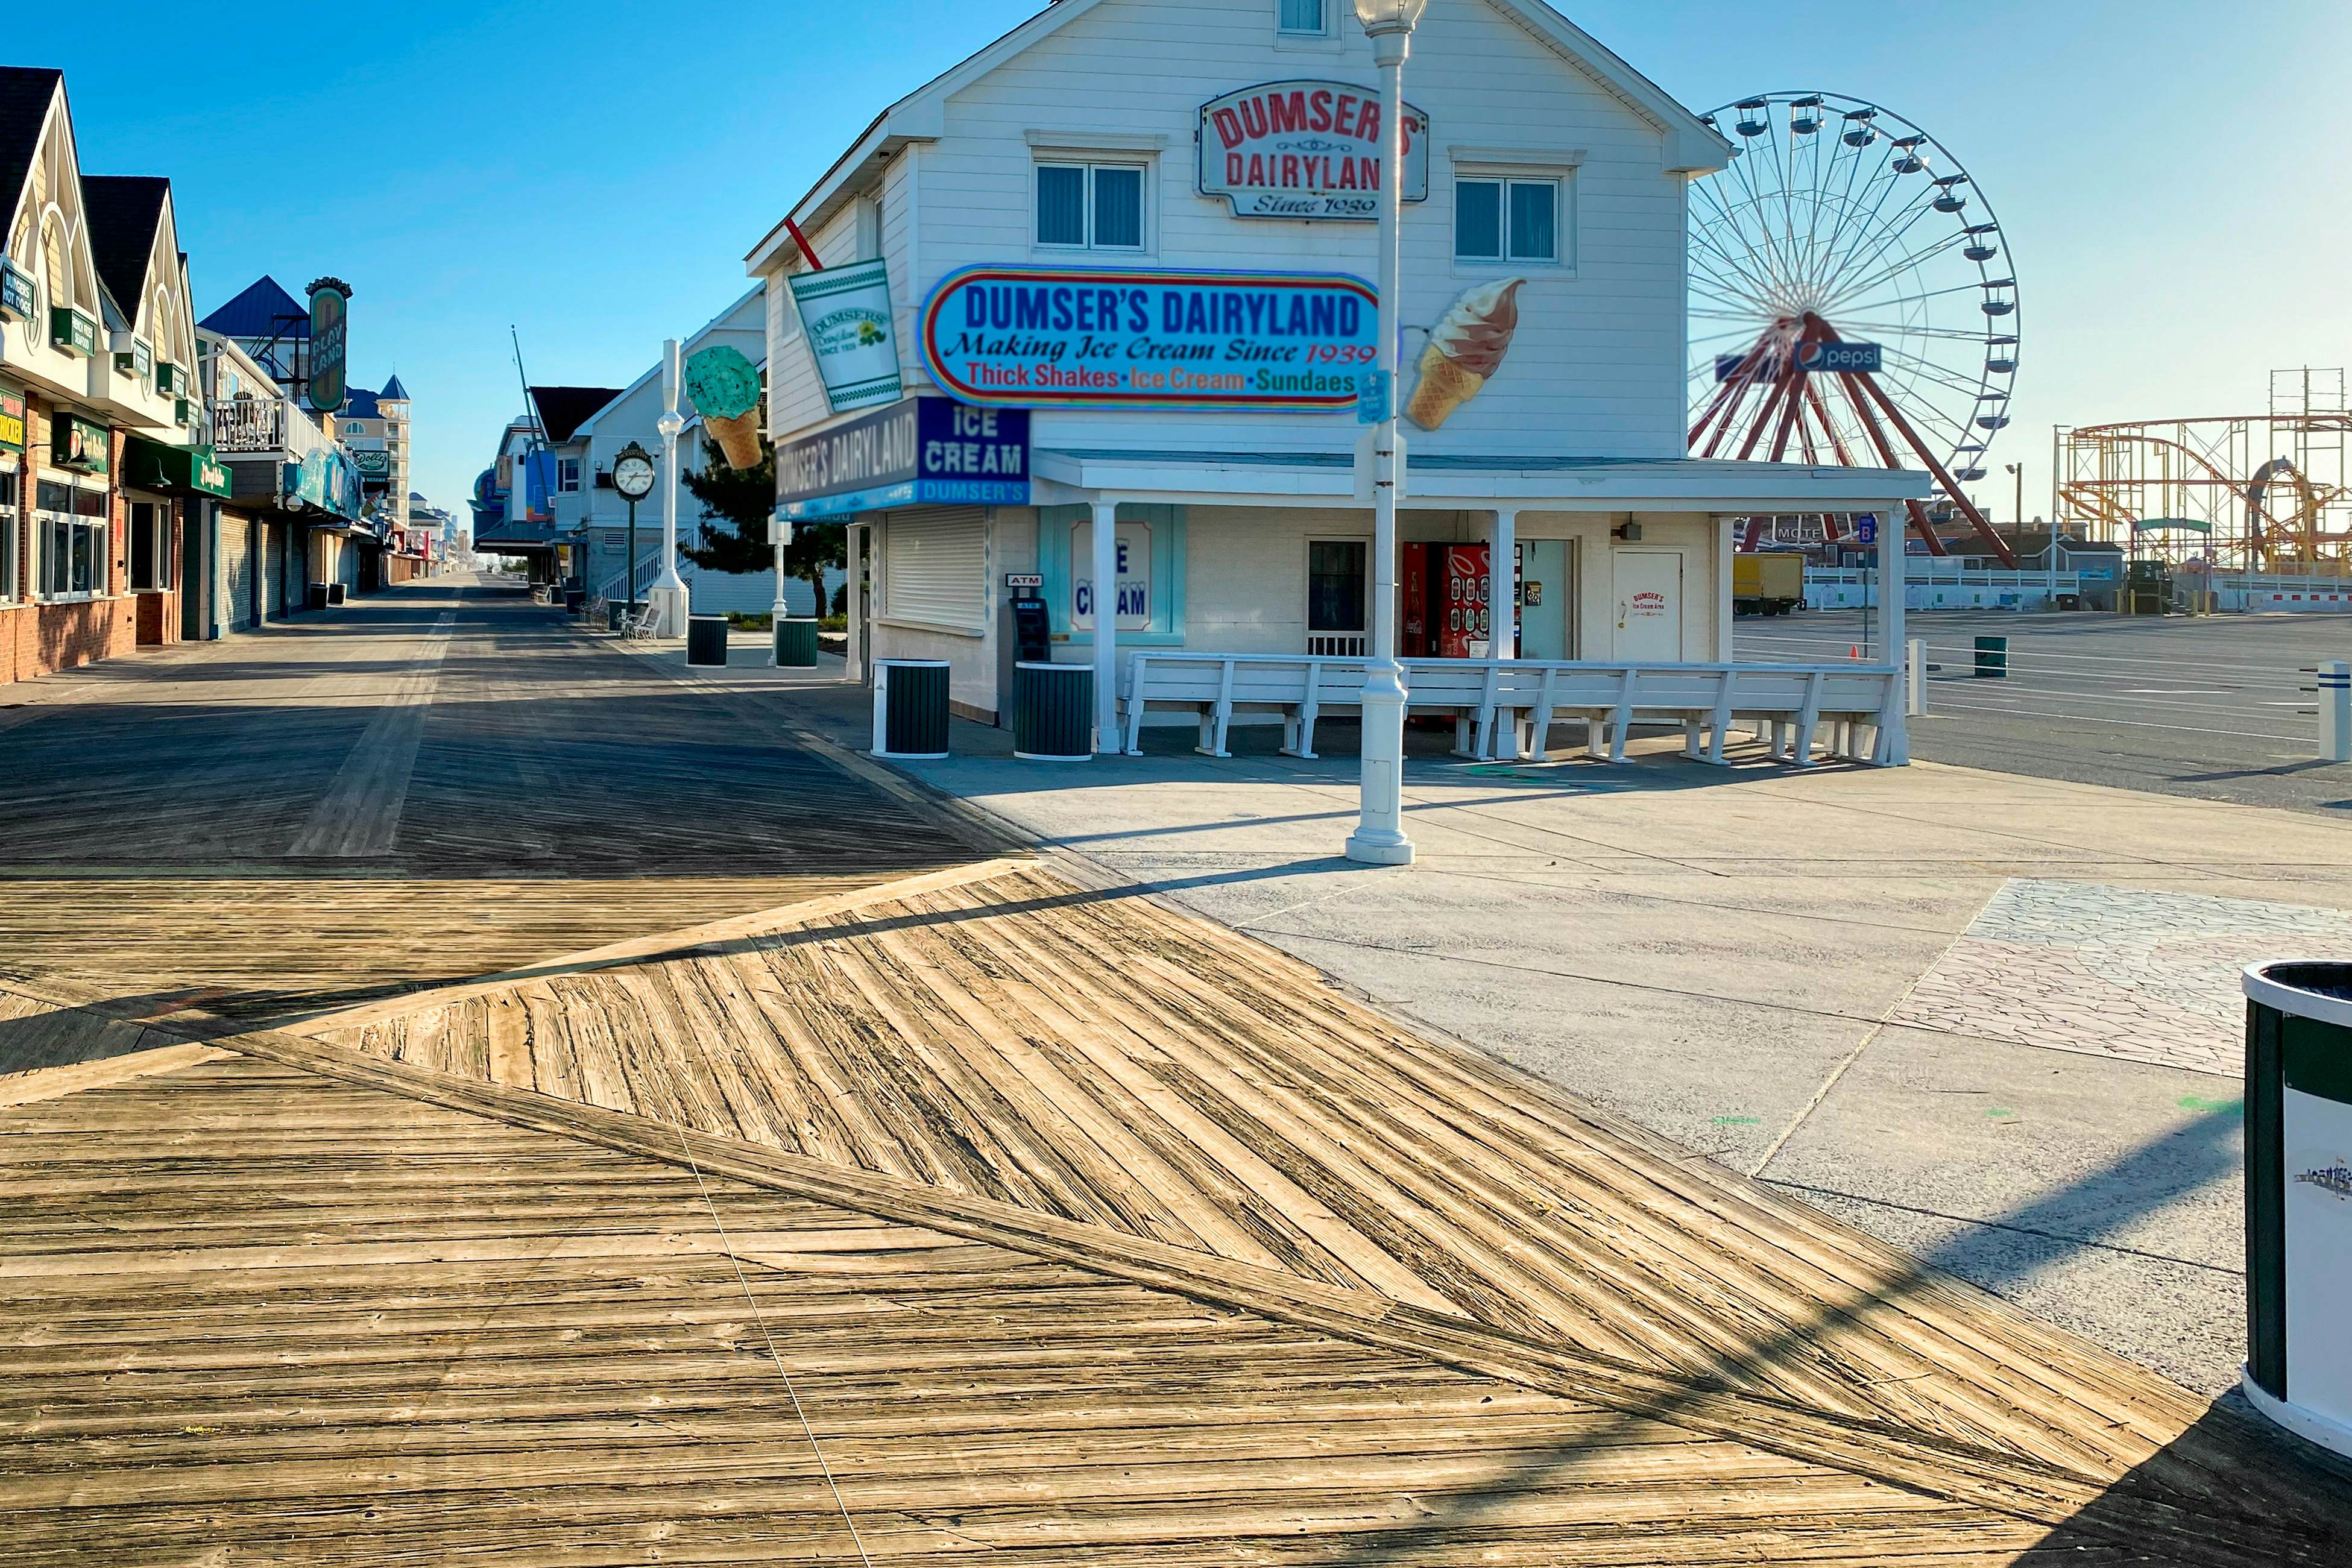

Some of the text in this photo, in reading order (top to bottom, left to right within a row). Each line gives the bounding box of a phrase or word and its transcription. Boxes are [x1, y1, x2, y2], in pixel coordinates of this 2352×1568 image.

[1212, 90, 1419, 157] DUMSERS
[1226, 153, 1381, 190] DAIRYLAN
[1253, 195, 1376, 213] Since 1939
[6, 273, 30, 298] BURGERS
[3, 288, 31, 315] HOT DOGS
[966, 285, 1359, 337] DUMSER'S DAIRYLAND
[312, 323, 342, 356] PLAY
[819, 346, 839, 356] SINCE
[943, 333, 1376, 365] Making Ice Cream Since 1939
[312, 344, 342, 376] LAND
[1827, 348, 1877, 367] pepsi
[966, 363, 1355, 392] Thick Shakes Ice Cream Sundaes
[954, 406, 998, 437] ICE
[778, 412, 917, 496] DUMSER'S DAIRYLAND
[925, 441, 1021, 474] CREAM
[924, 484, 1023, 501] DUMSER'S
[1779, 529, 1827, 540] MOTE
[1862, 526, 1870, 540] B
[1077, 587, 1144, 615] CAM
[1633, 593, 1664, 602] DUMSER'S
